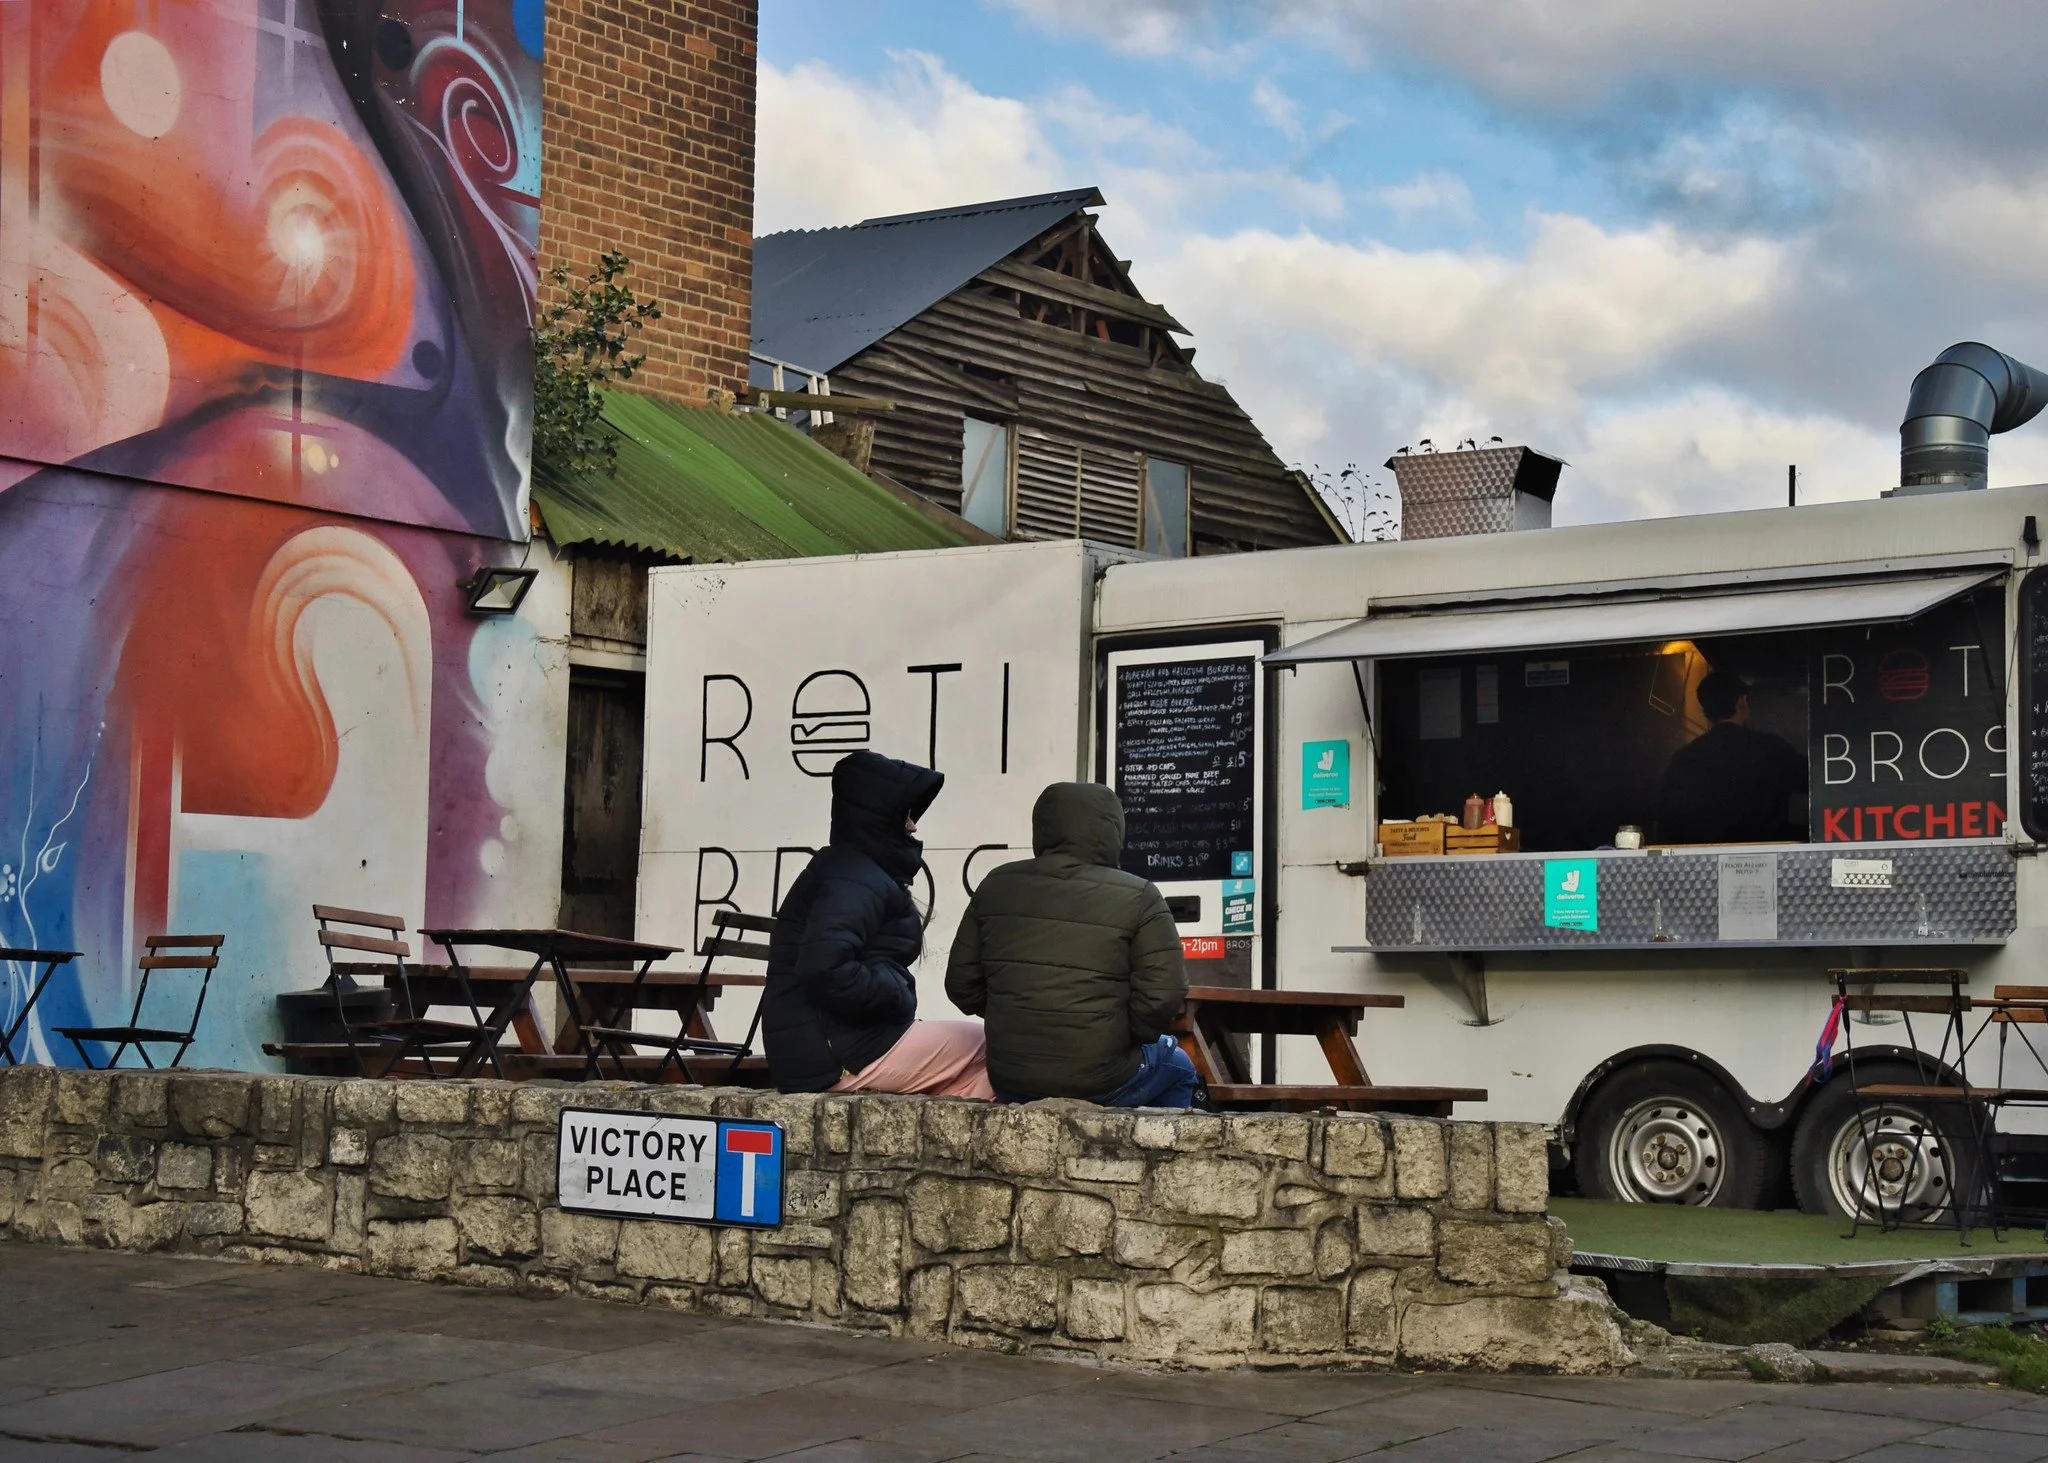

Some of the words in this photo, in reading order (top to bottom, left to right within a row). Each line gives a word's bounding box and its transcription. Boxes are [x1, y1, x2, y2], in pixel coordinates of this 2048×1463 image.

[1207, 664, 1236, 675] BURGER
[1823, 645, 1980, 704] ROT
[1402, 832, 1417, 842] Food
[1147, 853, 1183, 868] DRINKS
[1556, 893, 1586, 901] deliveroo
[1225, 904, 1245, 915] CHECK
[1231, 912, 1247, 922] HERE
[1226, 940, 1251, 950] BROS
[570, 1125, 708, 1163] VICTORY
[587, 1166, 686, 1202] PLACE
